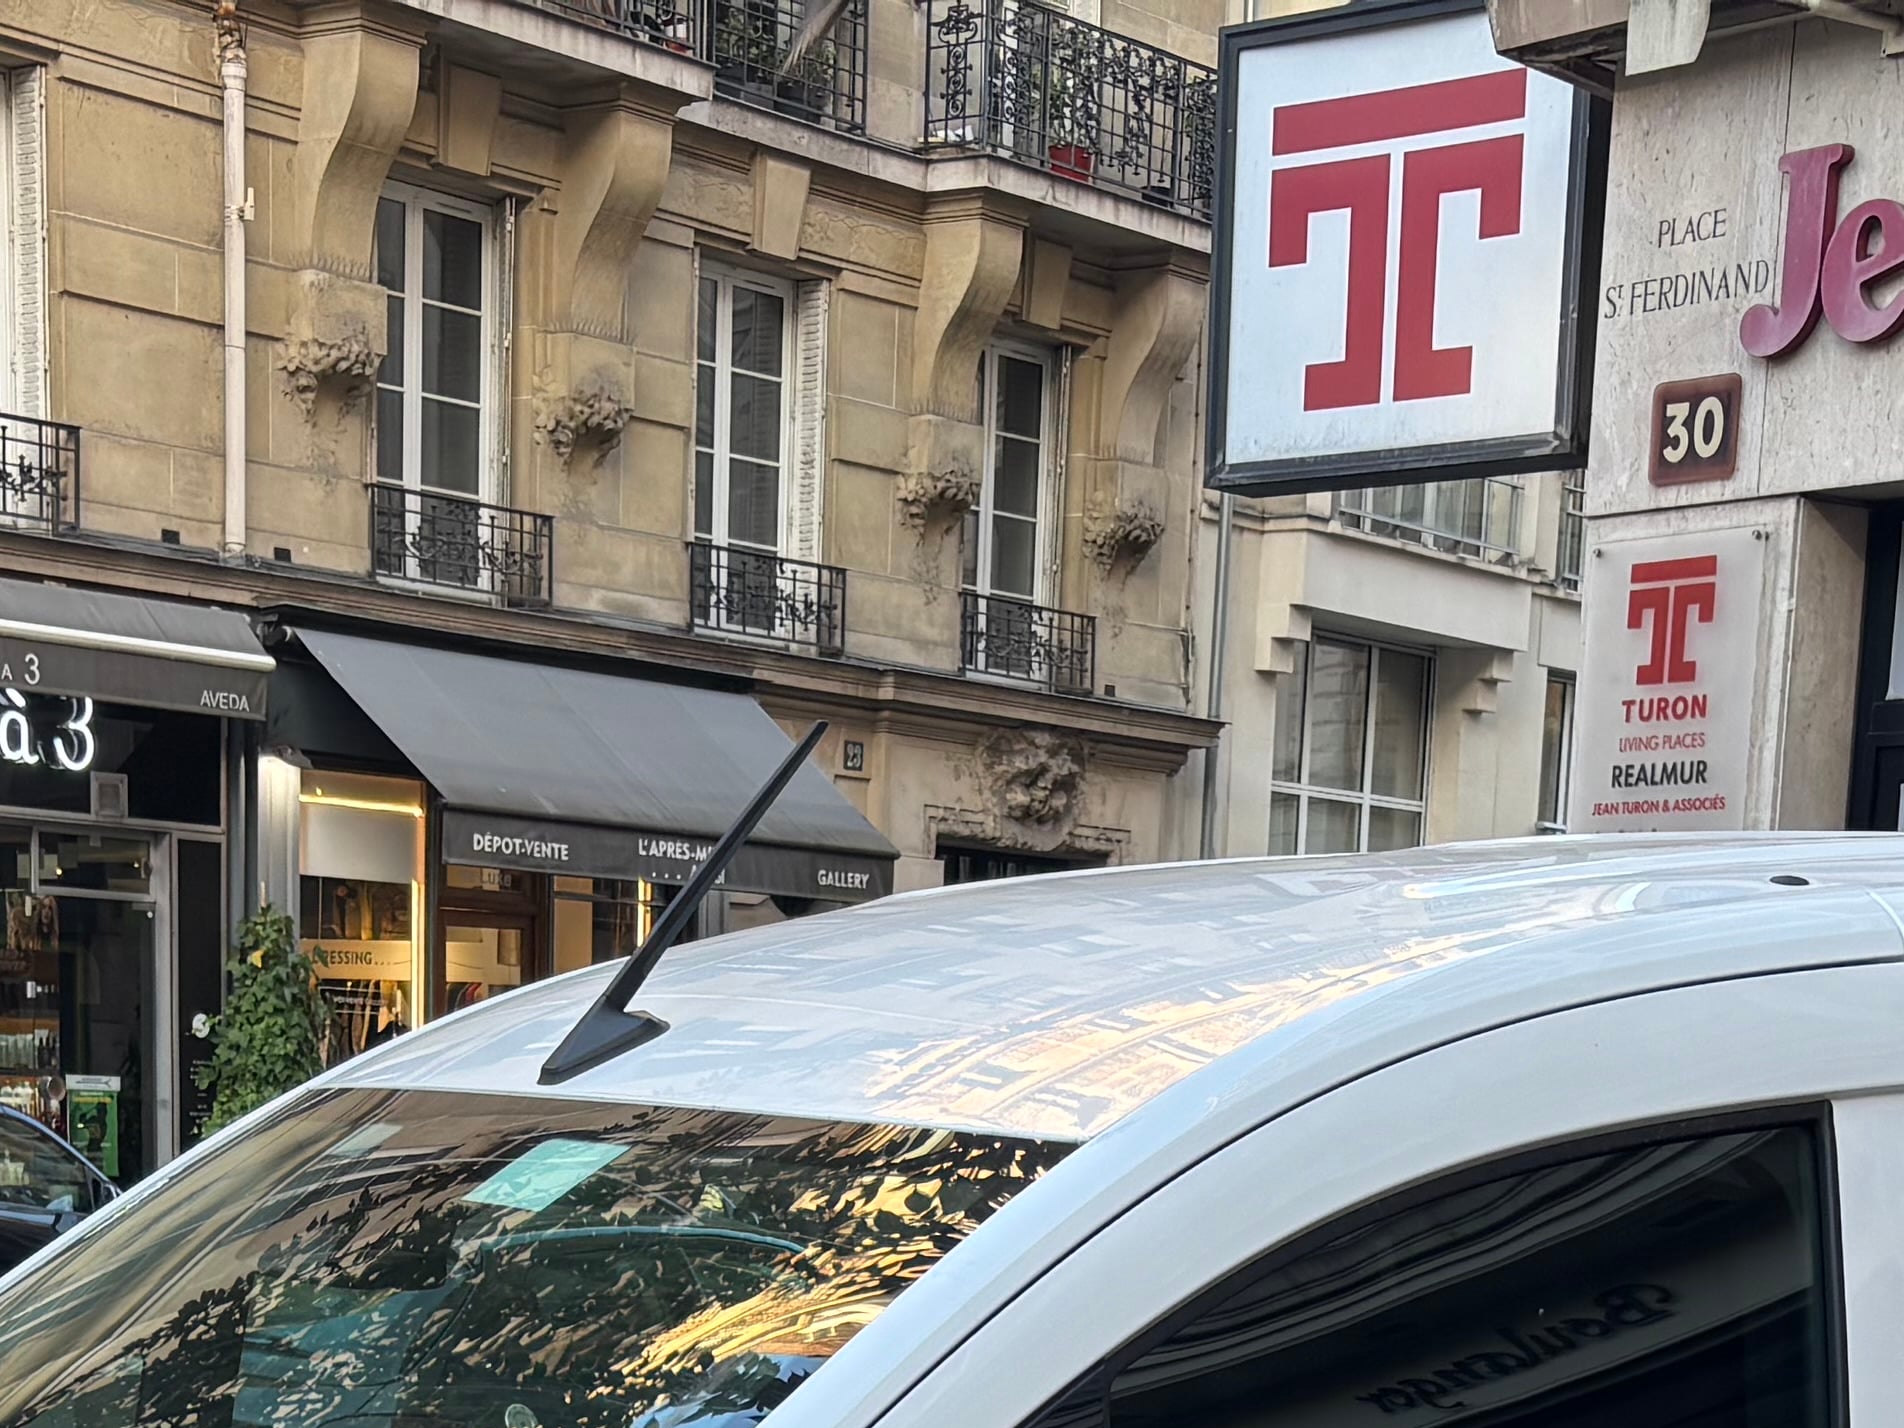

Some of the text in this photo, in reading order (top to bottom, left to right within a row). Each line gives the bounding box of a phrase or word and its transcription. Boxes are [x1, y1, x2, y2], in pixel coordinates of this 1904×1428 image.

[1657, 208, 1728, 249] PLACE
[1629, 259, 1771, 316] FERDINAND
[1663, 396, 1725, 464] 30
[23, 653, 41, 685] 3
[199, 689, 250, 713] AVEDA
[1621, 693, 1708, 724] TURON
[52, 696, 96, 773] 3
[1618, 732, 1706, 753] LIVING PLACES
[847, 743, 862, 768] 23
[1610, 760, 1709, 789] REALMUR
[1592, 793, 1727, 817] JEAN TURON & ASSOCIÉS
[472, 831, 569, 861] DÉPOT-VENTE
[817, 869, 870, 889] GALLERY
